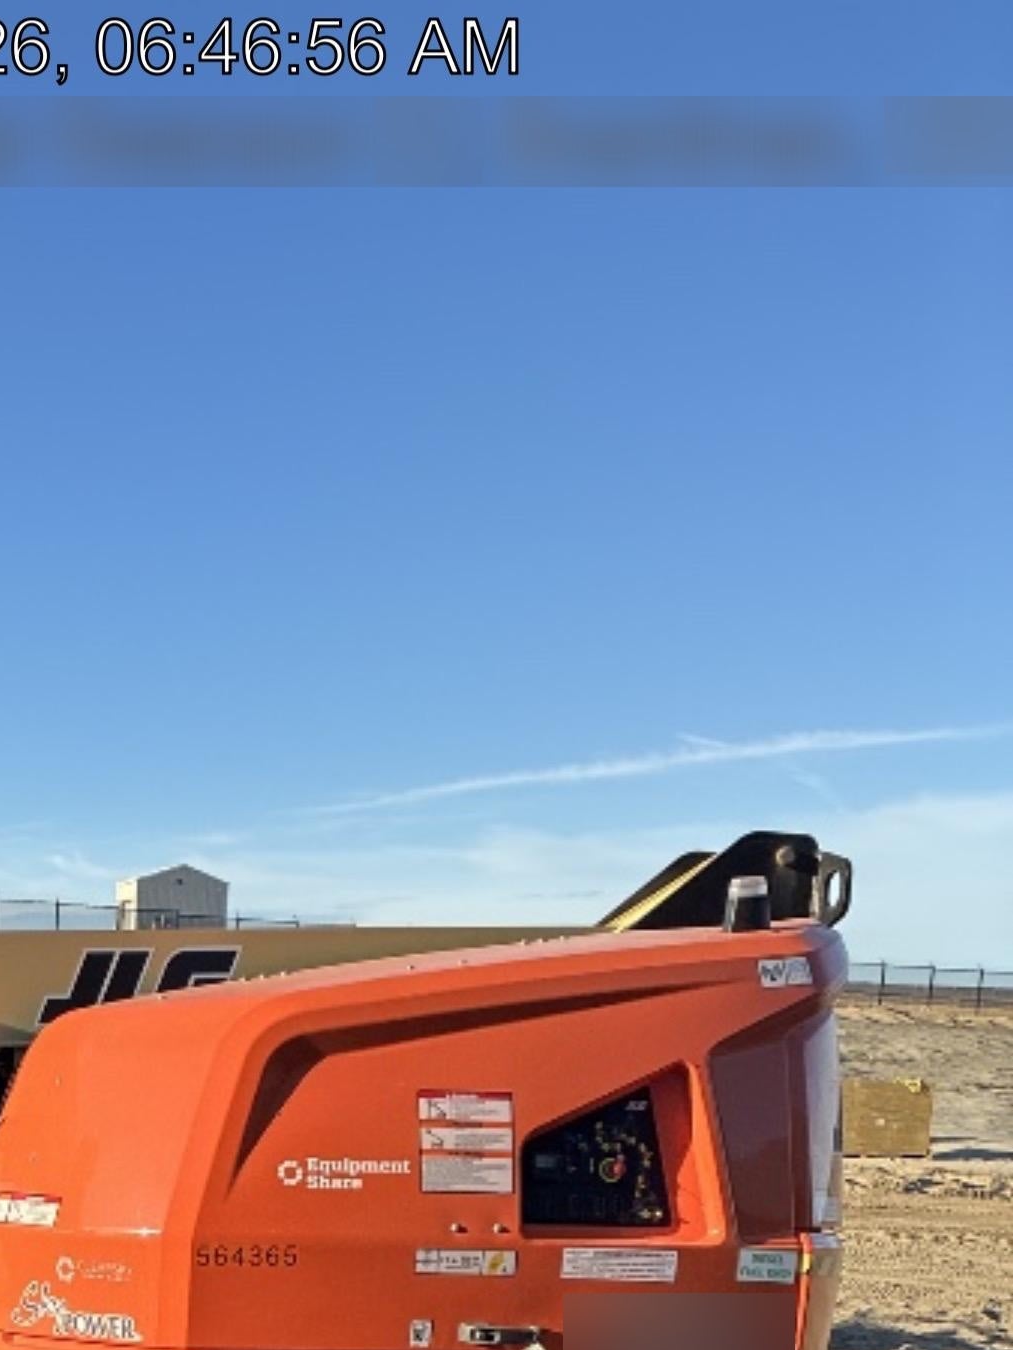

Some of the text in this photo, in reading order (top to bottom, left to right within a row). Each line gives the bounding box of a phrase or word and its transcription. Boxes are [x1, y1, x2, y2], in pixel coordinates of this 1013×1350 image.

[306, 1157, 411, 1176] Equipment
[306, 1175, 363, 1189] Share
[196, 1244, 298, 1267] 564365
